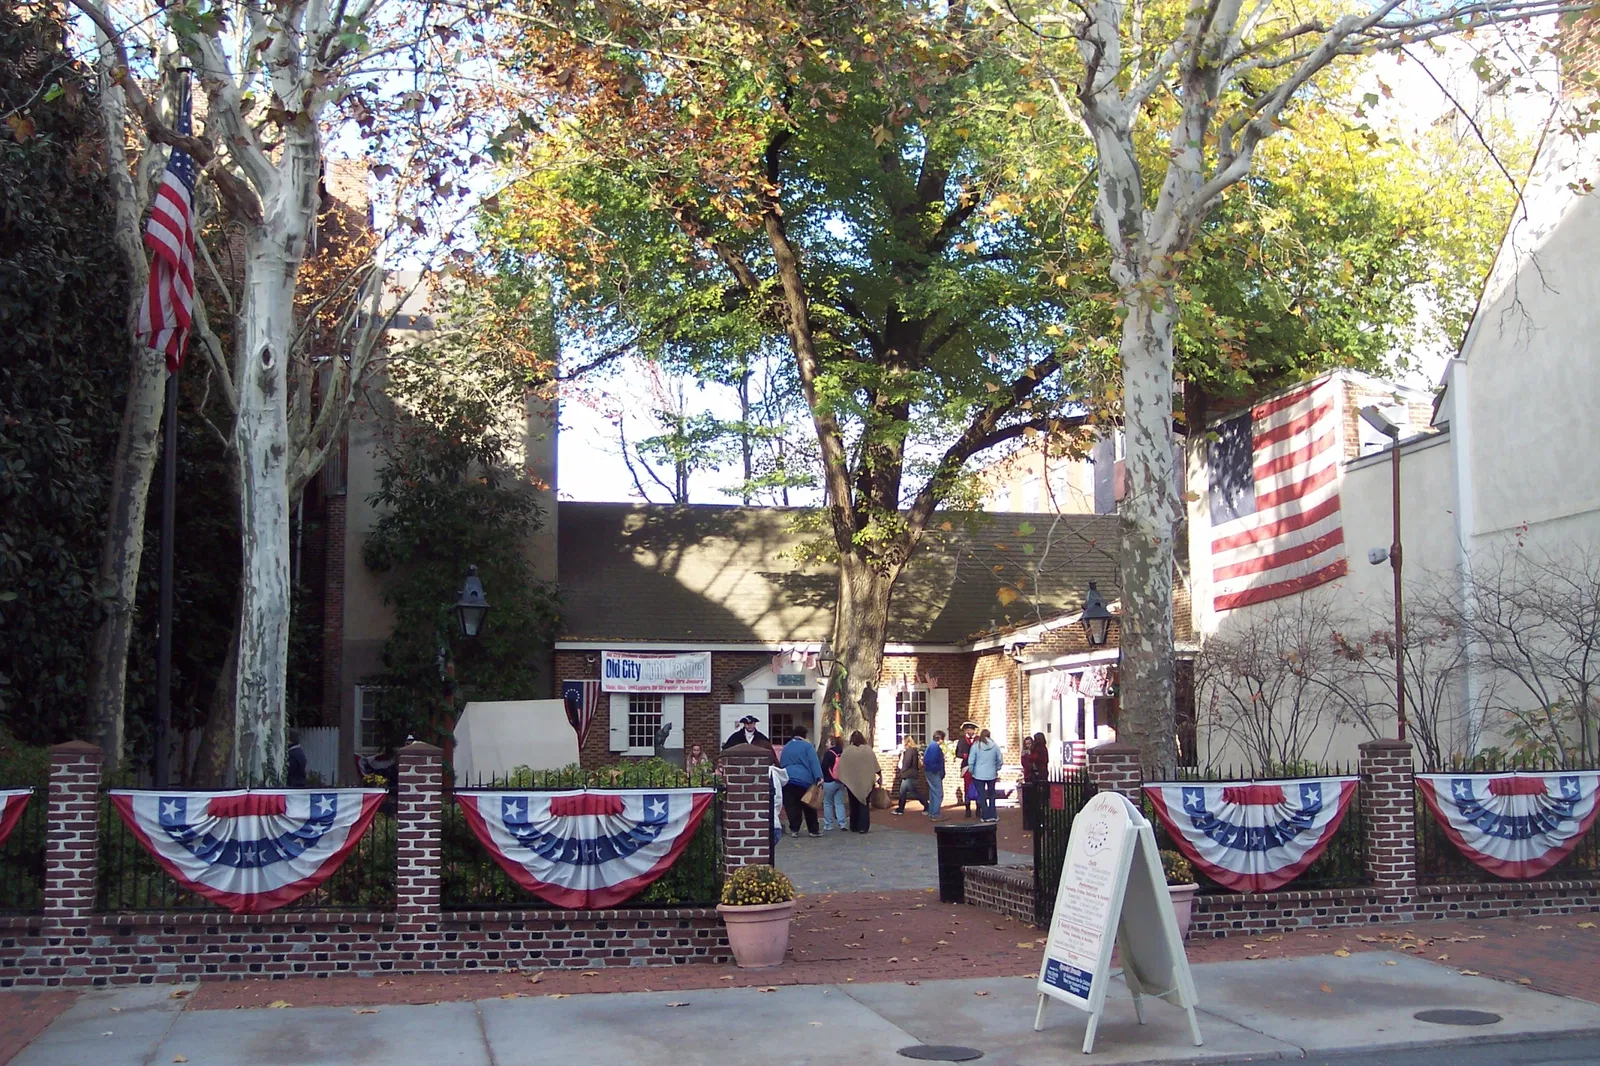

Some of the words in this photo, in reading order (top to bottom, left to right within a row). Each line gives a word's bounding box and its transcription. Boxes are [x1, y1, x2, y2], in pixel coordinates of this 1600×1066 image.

[606, 658, 620, 679] Old
[622, 659, 641, 682] City
[642, 660, 666, 682] Light
